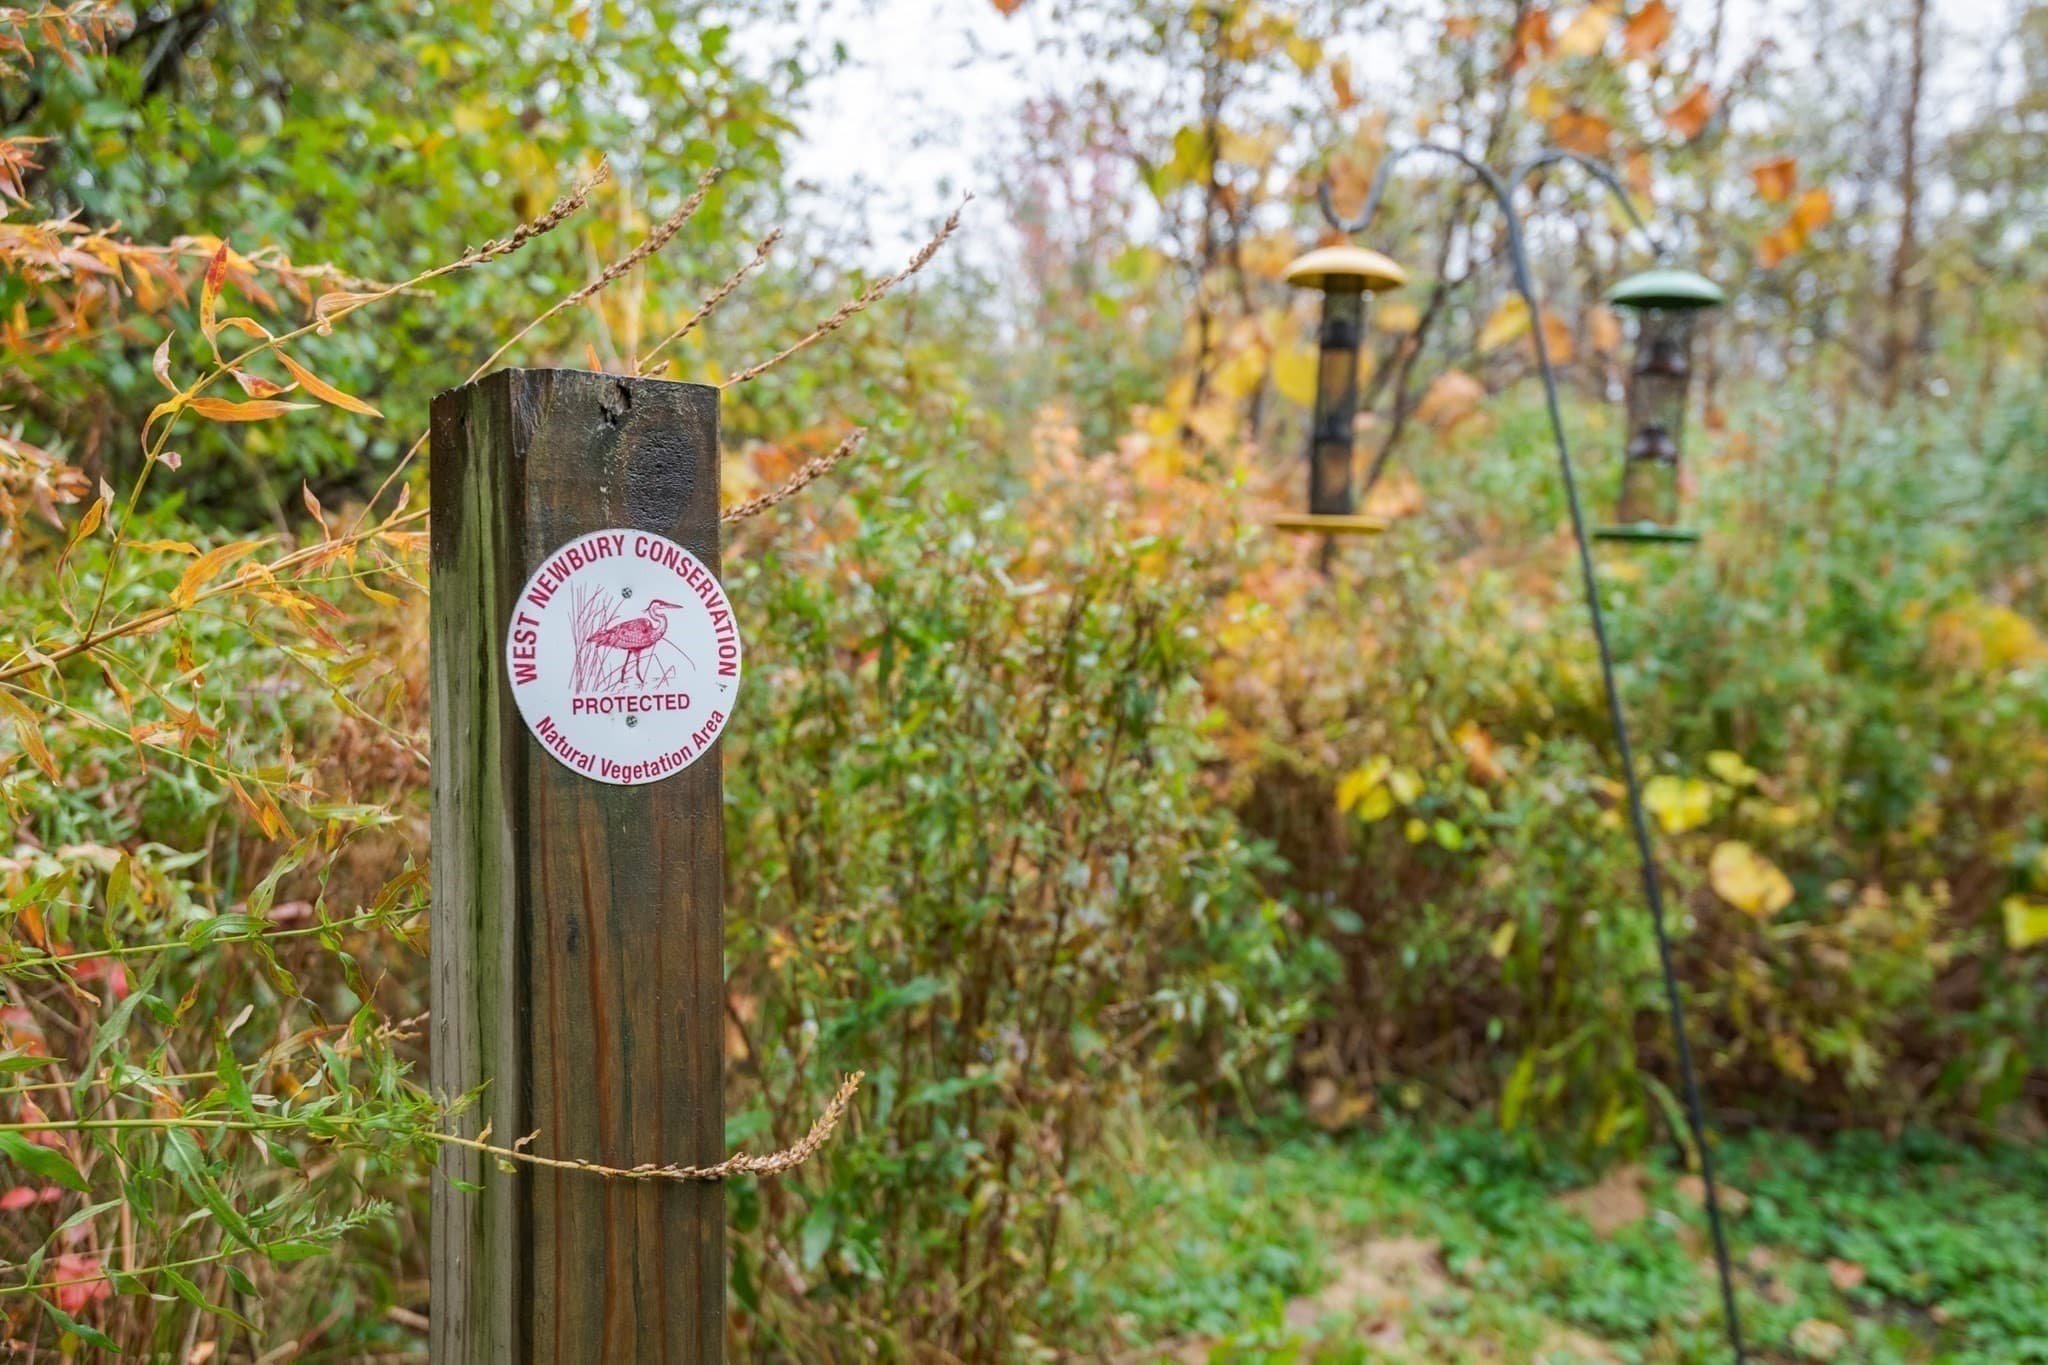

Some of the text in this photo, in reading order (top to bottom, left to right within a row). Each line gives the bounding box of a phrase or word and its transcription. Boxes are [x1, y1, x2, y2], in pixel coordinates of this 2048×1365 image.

[513, 534, 738, 686] WEST NEWBURY CONSERVATION
[572, 693, 691, 715] PROTECTED
[535, 708, 725, 784] Natural Vegetation Area
